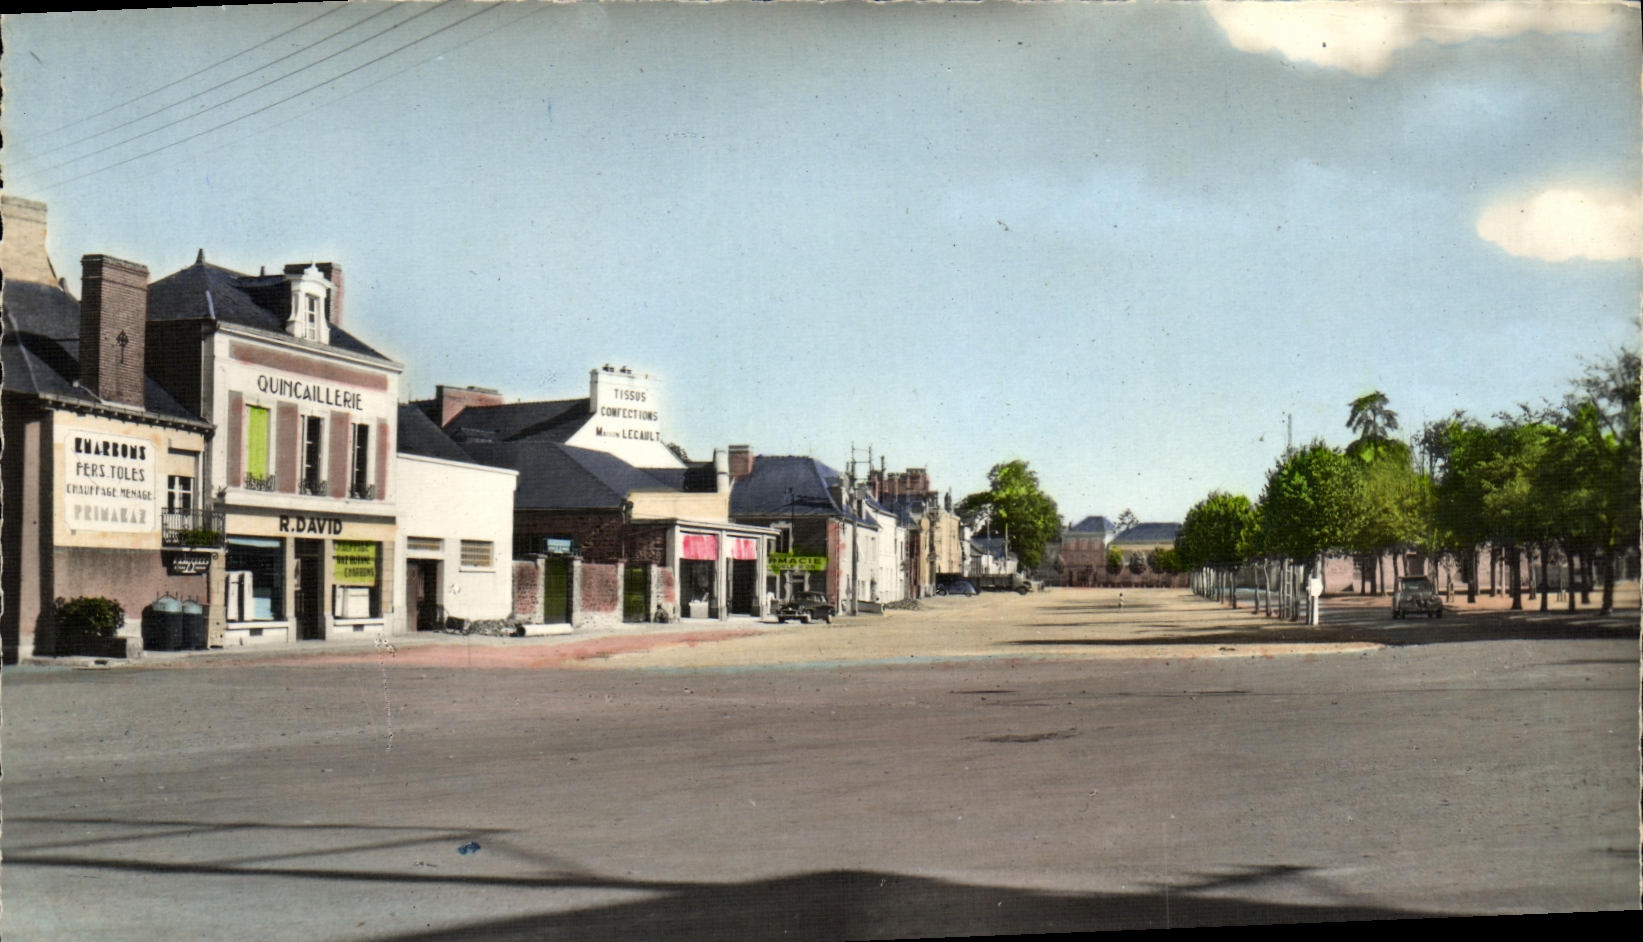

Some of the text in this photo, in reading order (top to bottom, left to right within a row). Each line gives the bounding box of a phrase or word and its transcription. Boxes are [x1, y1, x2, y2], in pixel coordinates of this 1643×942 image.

[257, 374, 363, 411] QUINCAILLERIE
[614, 388, 646, 402] TISSUS
[600, 406, 658, 421] CONFECTIONS
[110, 464, 145, 482] TOLES
[66, 483, 117, 498] CHAUFFAGE
